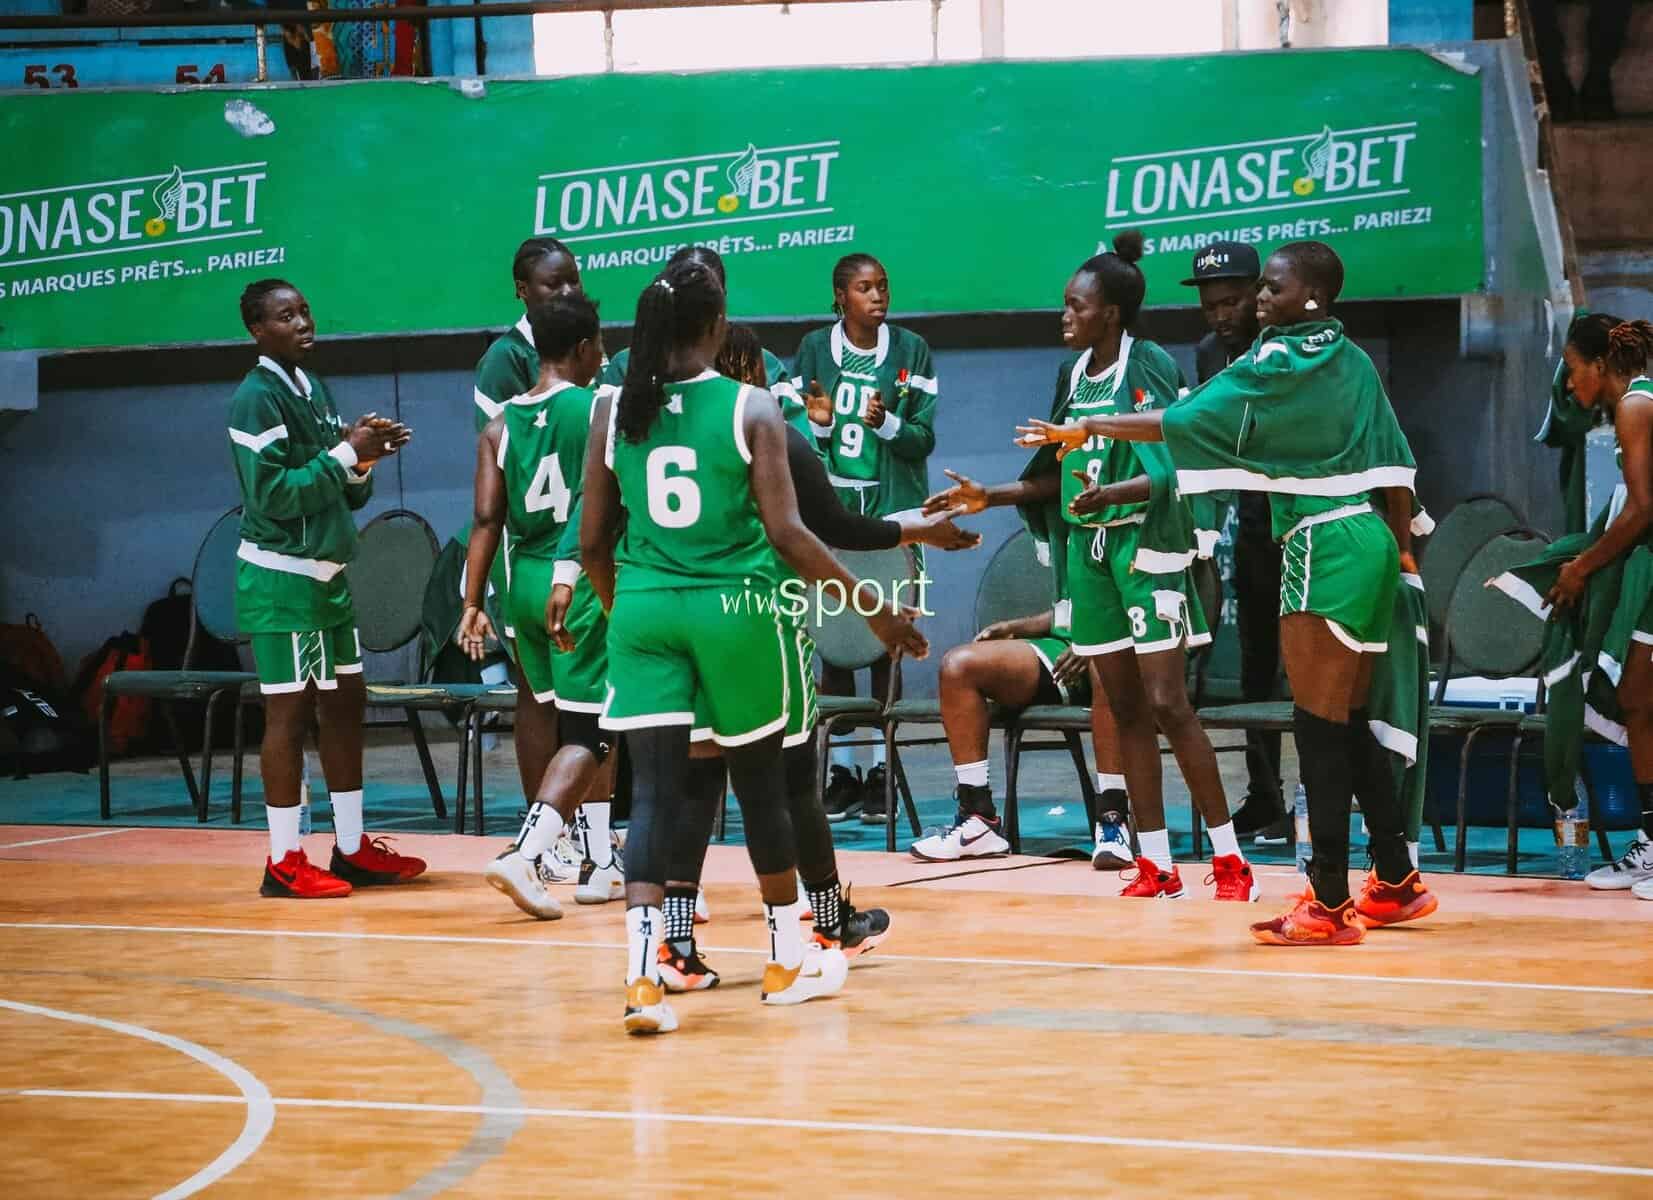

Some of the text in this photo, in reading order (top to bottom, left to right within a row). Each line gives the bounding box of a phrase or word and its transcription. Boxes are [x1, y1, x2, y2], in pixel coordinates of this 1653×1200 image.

[749, 152, 839, 210] BET
[1325, 133, 1416, 192] BET
[177, 172, 266, 233] BET
[1353, 207, 1432, 230] PARIEZ!
[778, 225, 855, 248] PARIEZ!
[11, 268, 115, 298] MARQUES
[208, 247, 285, 272] PARIEZ!
[839, 423, 864, 457] 9
[524, 452, 571, 524] 4
[646, 445, 701, 529] 6
[1128, 606, 1147, 637] 8
